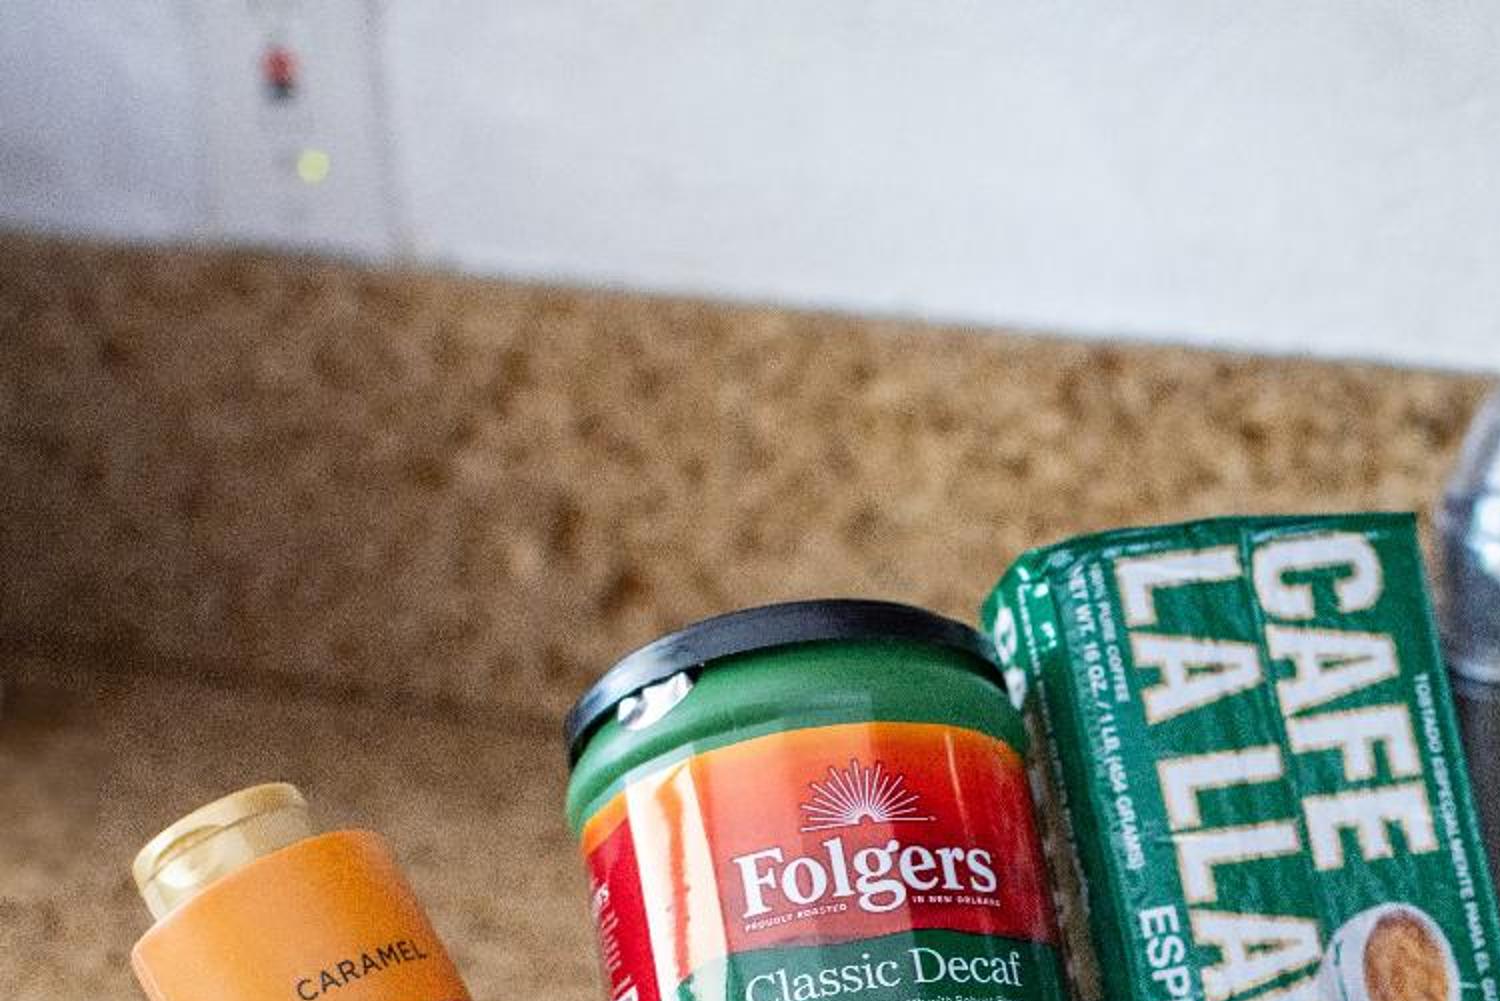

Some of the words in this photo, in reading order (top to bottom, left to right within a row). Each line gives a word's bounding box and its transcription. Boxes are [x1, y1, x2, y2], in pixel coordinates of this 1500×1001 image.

[1113, 544, 1266, 726] LA
[1106, 645, 1131, 703] COFFEE
[1250, 530, 1440, 872] CAFE
[1414, 673, 1443, 754] TOSTADO
[1431, 756, 1475, 899] ESPECIALMENTE
[733, 836, 998, 913] Folgers
[744, 913, 794, 933] PROUDLY
[796, 903, 848, 919] ROASTED
[297, 939, 428, 1001] CARAMEL
[909, 947, 1024, 987] Decaf
